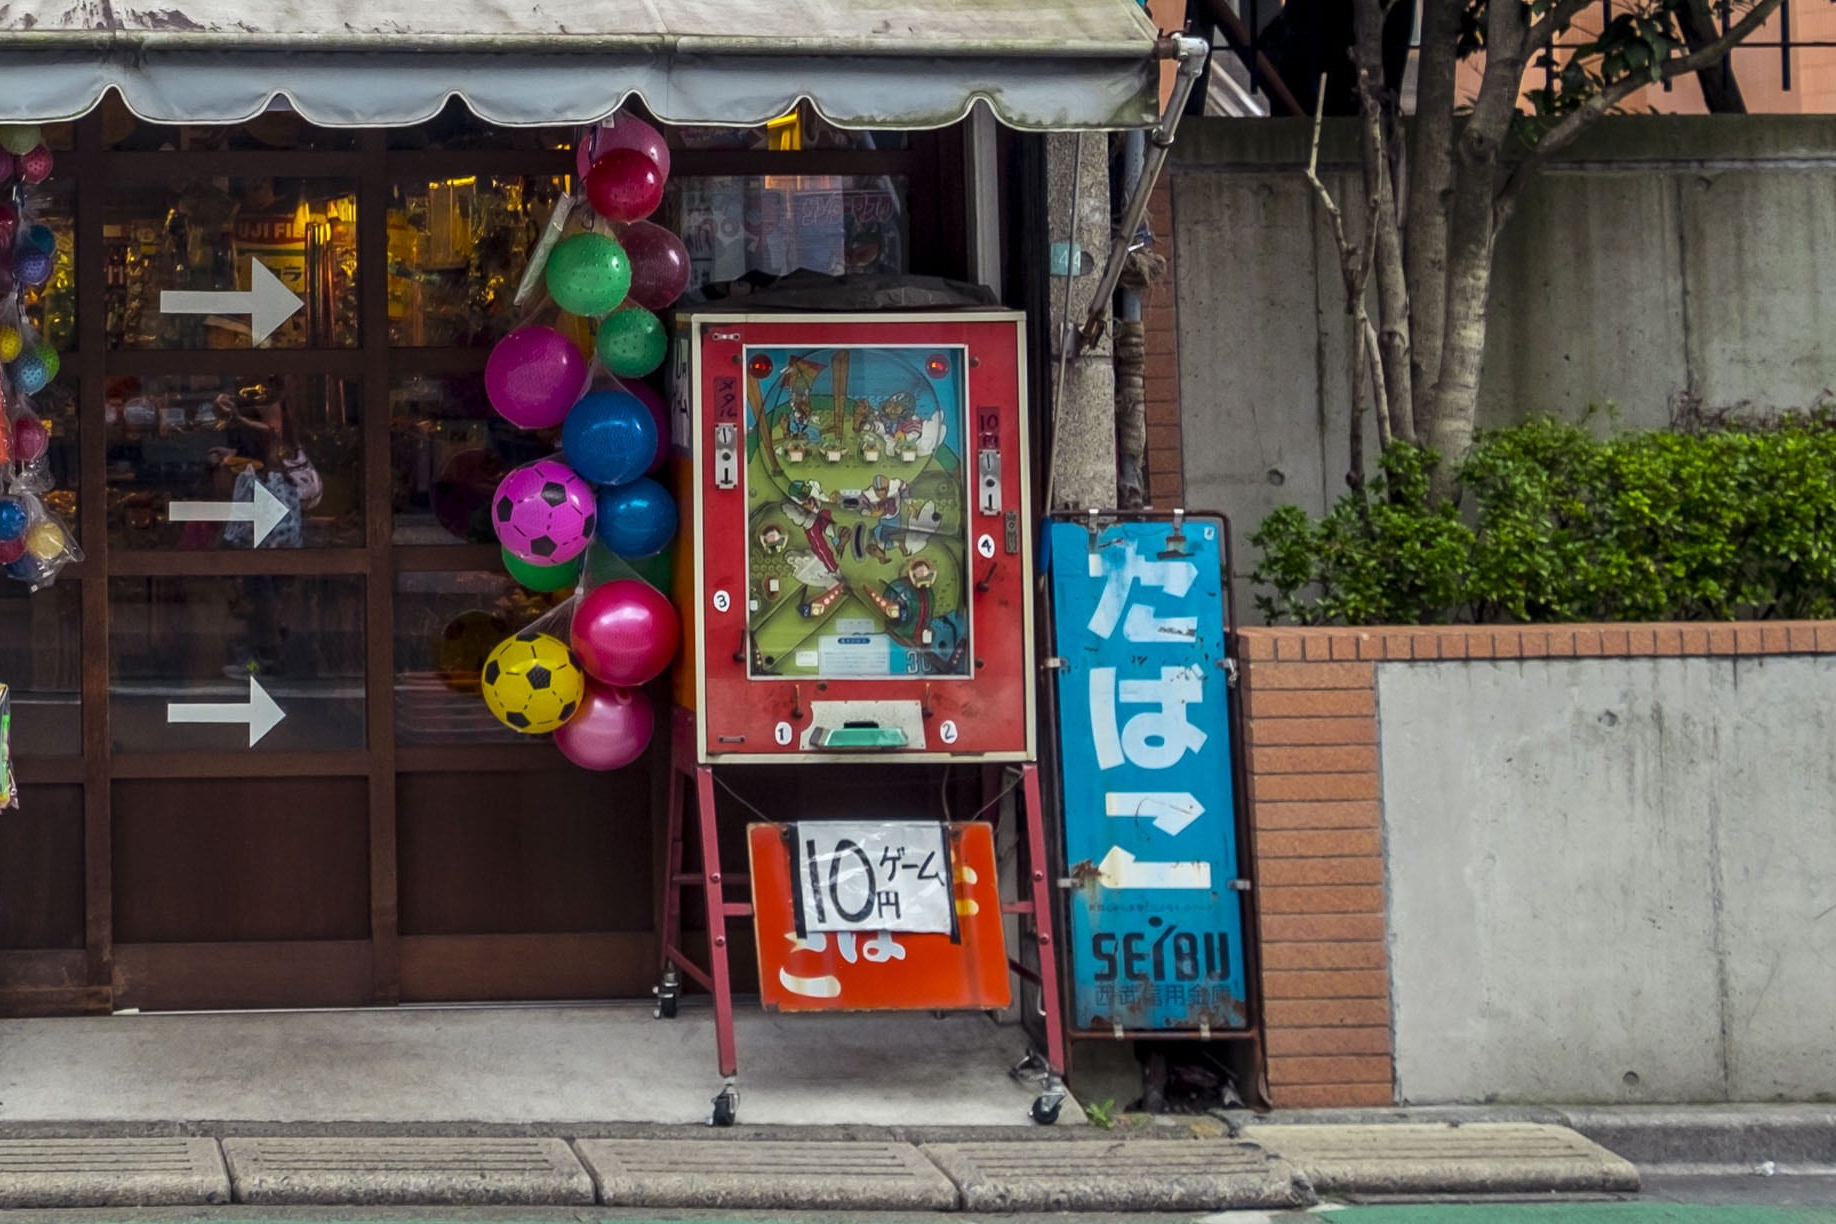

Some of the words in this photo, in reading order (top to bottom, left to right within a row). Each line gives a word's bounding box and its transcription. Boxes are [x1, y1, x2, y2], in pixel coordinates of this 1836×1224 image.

[238, 222, 269, 239] UJI
[274, 222, 306, 239] FIL
[980, 536, 995, 555] 4
[714, 592, 729, 610] 3
[1086, 537, 1212, 890] たばこ
[942, 721, 958, 743] 2
[878, 845, 946, 888] ゲーム
[806, 838, 877, 925] 10
[876, 891, 902, 920] 円
